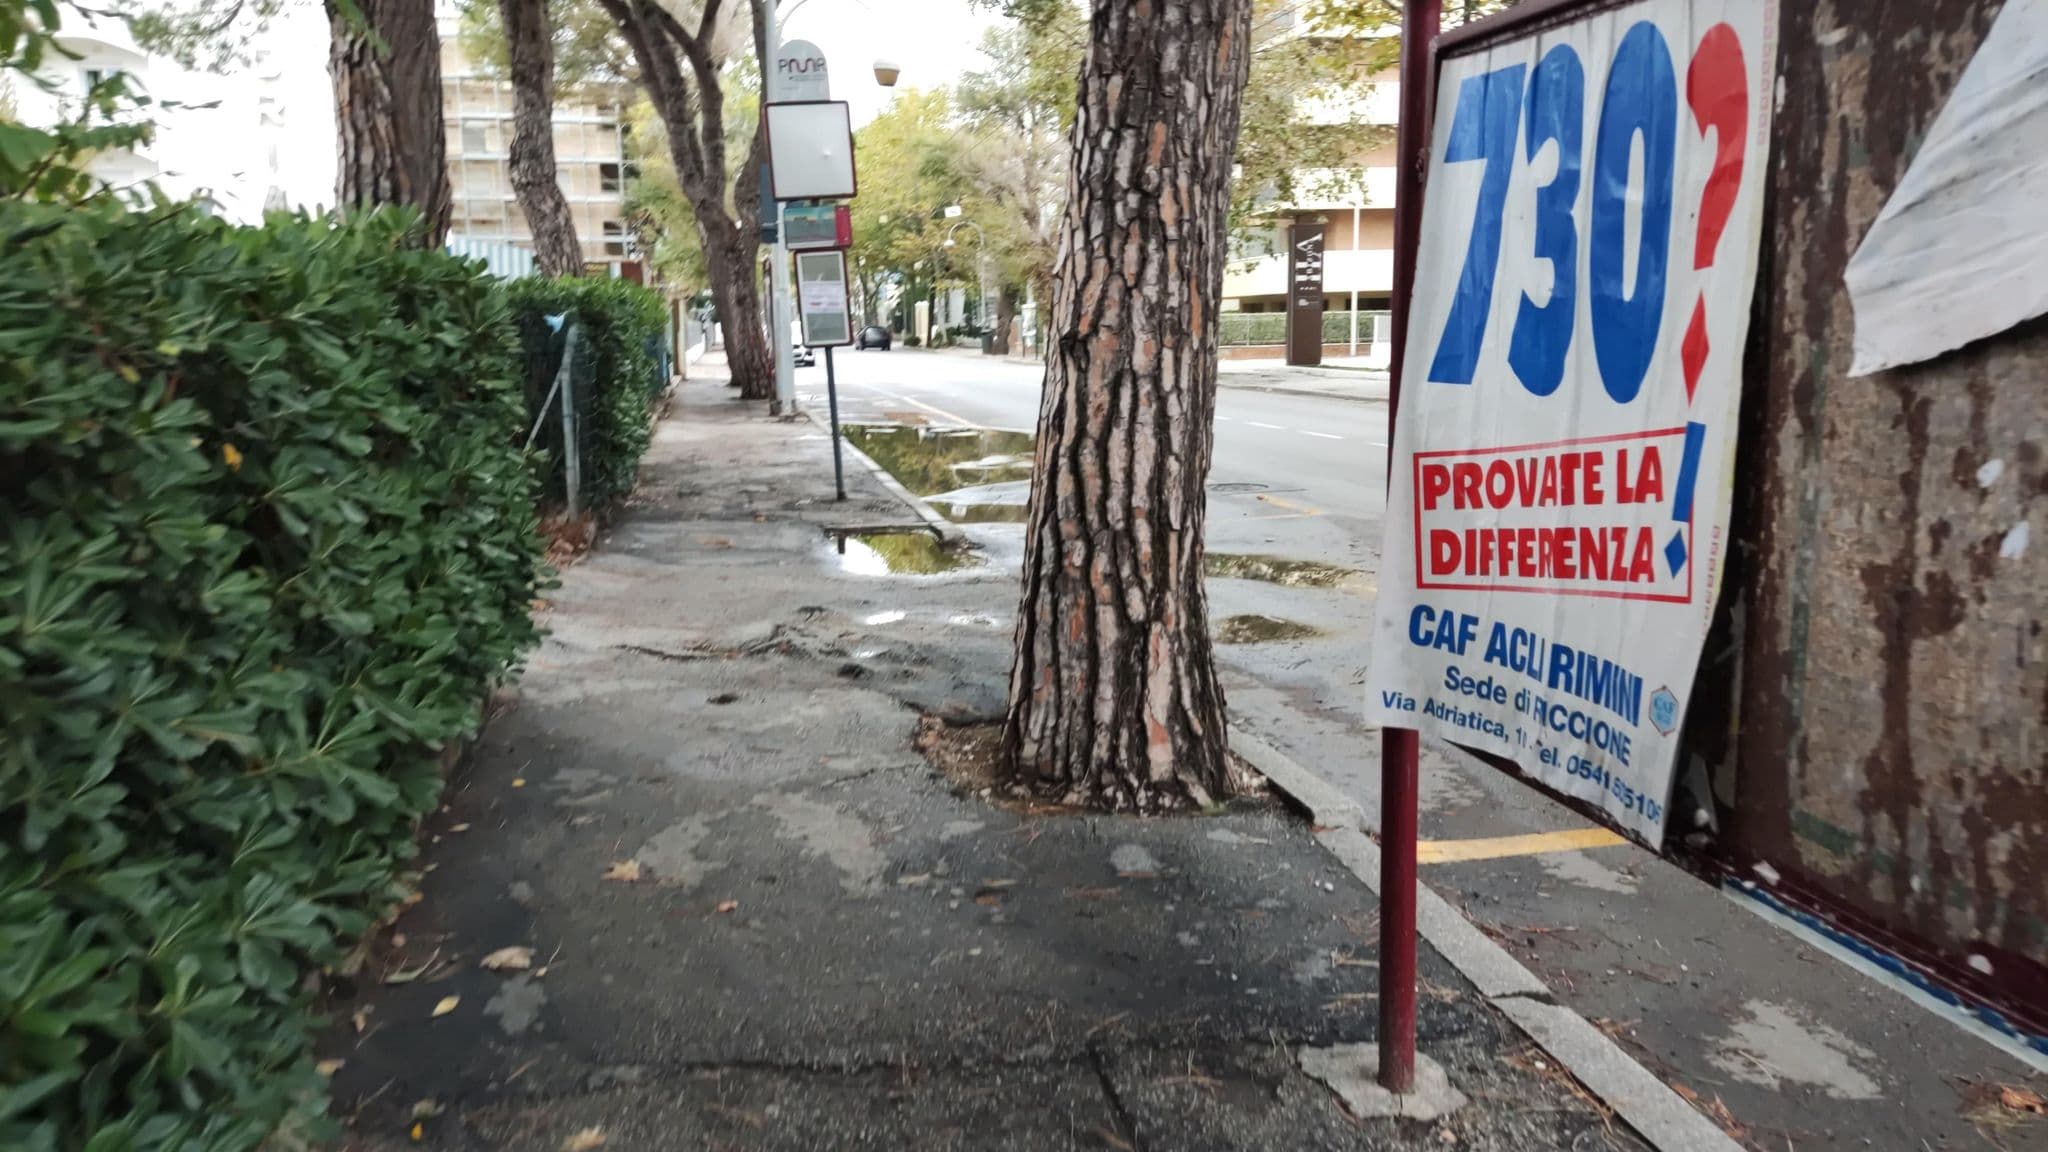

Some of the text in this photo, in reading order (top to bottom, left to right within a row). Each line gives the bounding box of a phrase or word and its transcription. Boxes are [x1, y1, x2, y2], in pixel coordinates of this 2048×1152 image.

[1427, 20, 1749, 408] 730?
[1422, 446, 1664, 510] PROVATE LA
[1408, 604, 1643, 728] CAF ACLI RIMINI
[1444, 665, 1508, 705] Sede
[1514, 687, 1532, 716] di
[1381, 690, 1417, 712] Via
[1423, 697, 1510, 744] Adriatica,
